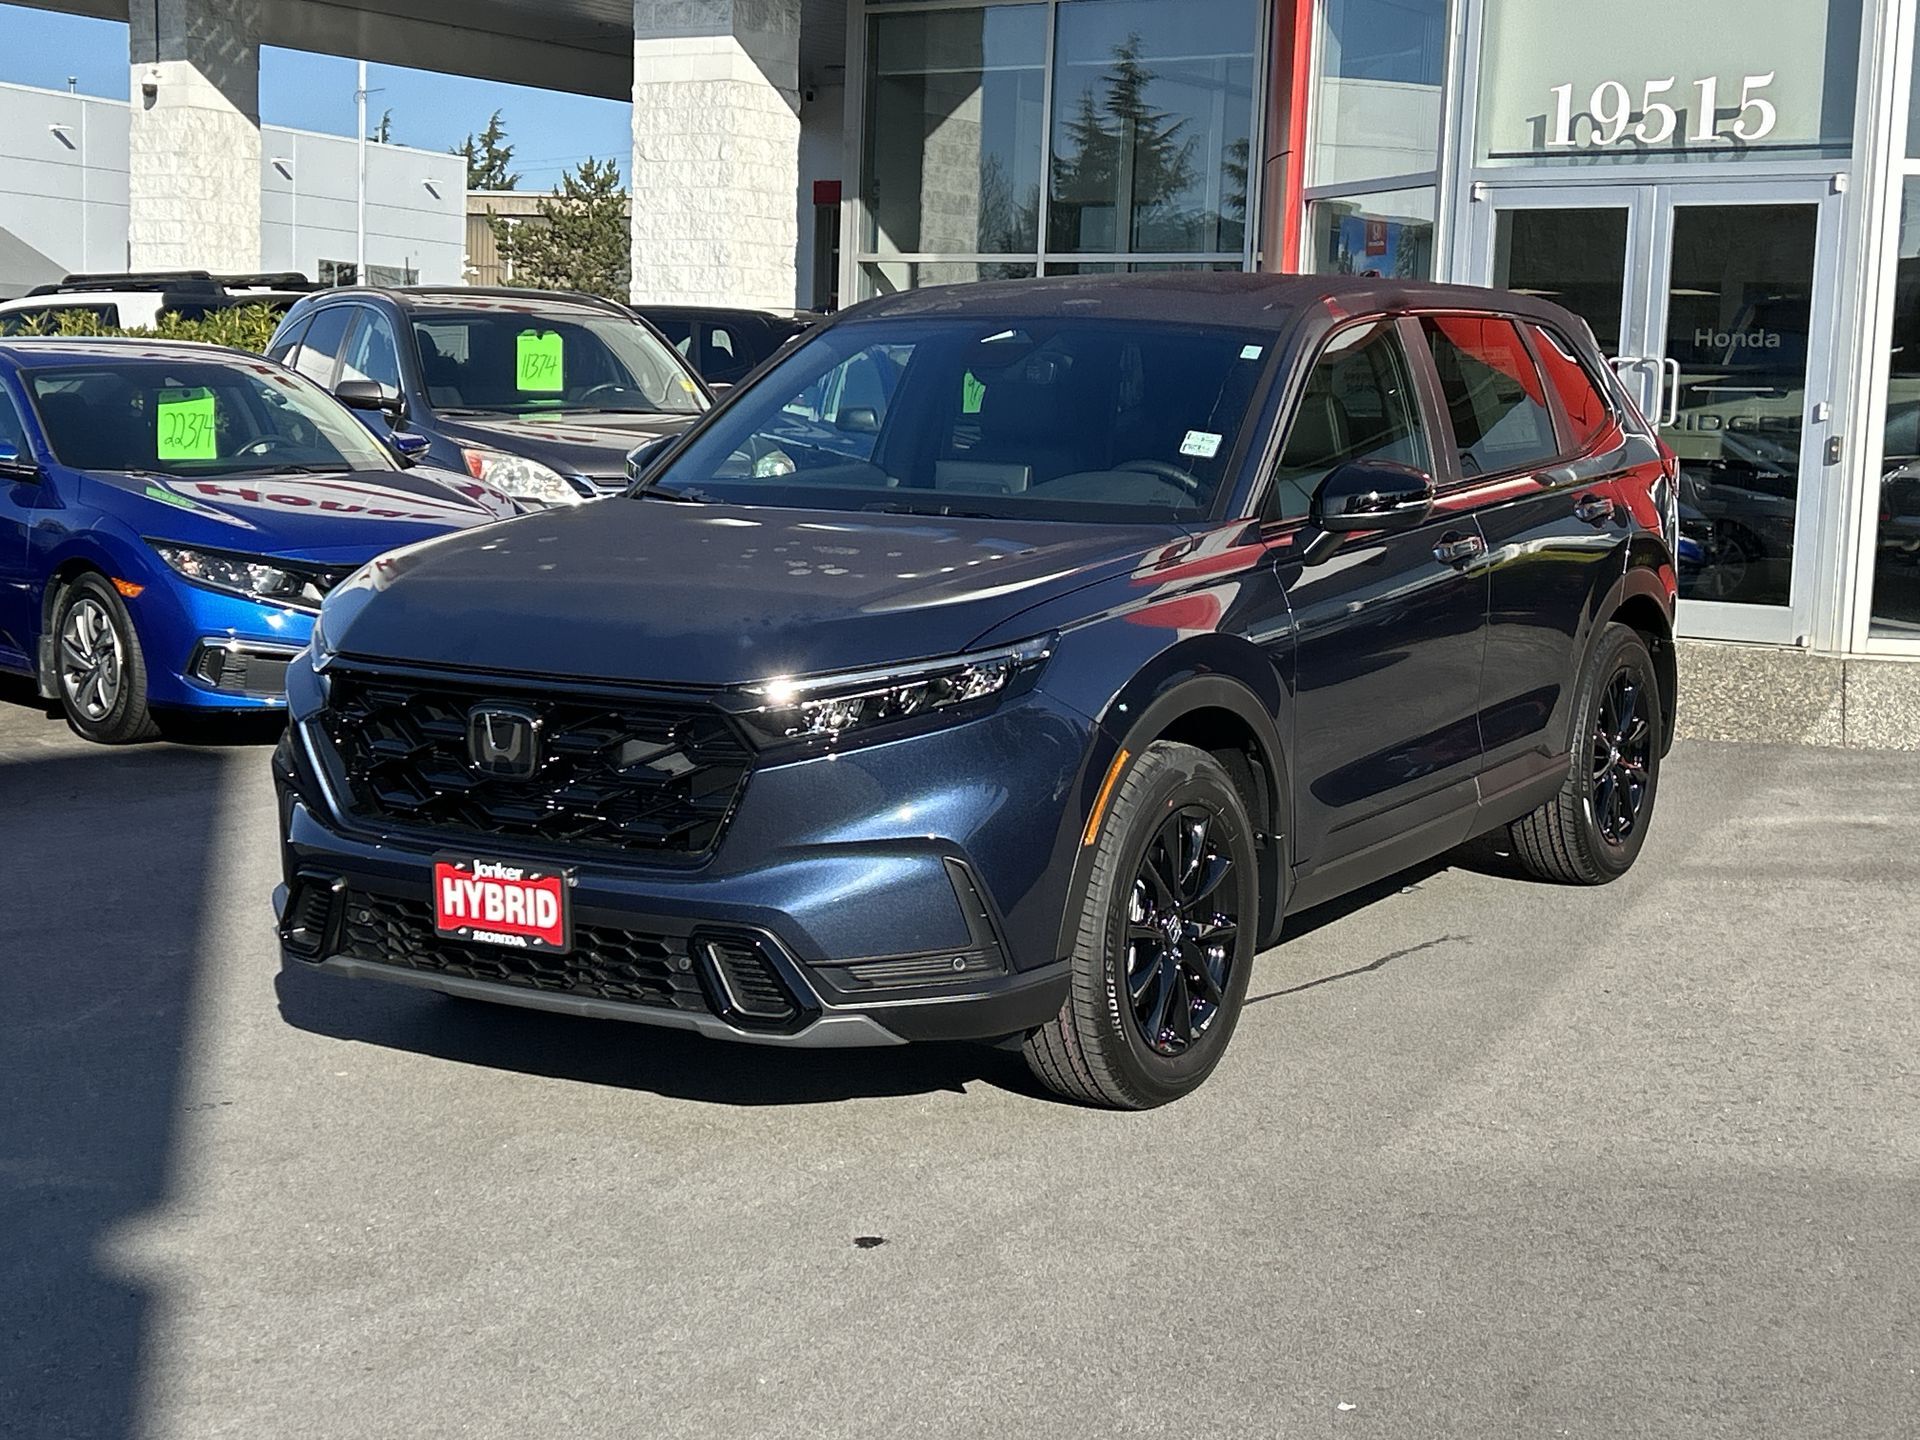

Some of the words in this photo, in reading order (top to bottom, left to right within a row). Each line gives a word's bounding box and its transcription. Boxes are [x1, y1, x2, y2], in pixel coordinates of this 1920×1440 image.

[1547, 71, 1777, 146] 19515
[1694, 328, 1781, 348] Honda
[164, 412, 215, 450] 22374
[442, 877, 558, 929] HYBRID
[473, 930, 527, 947] HONDA
